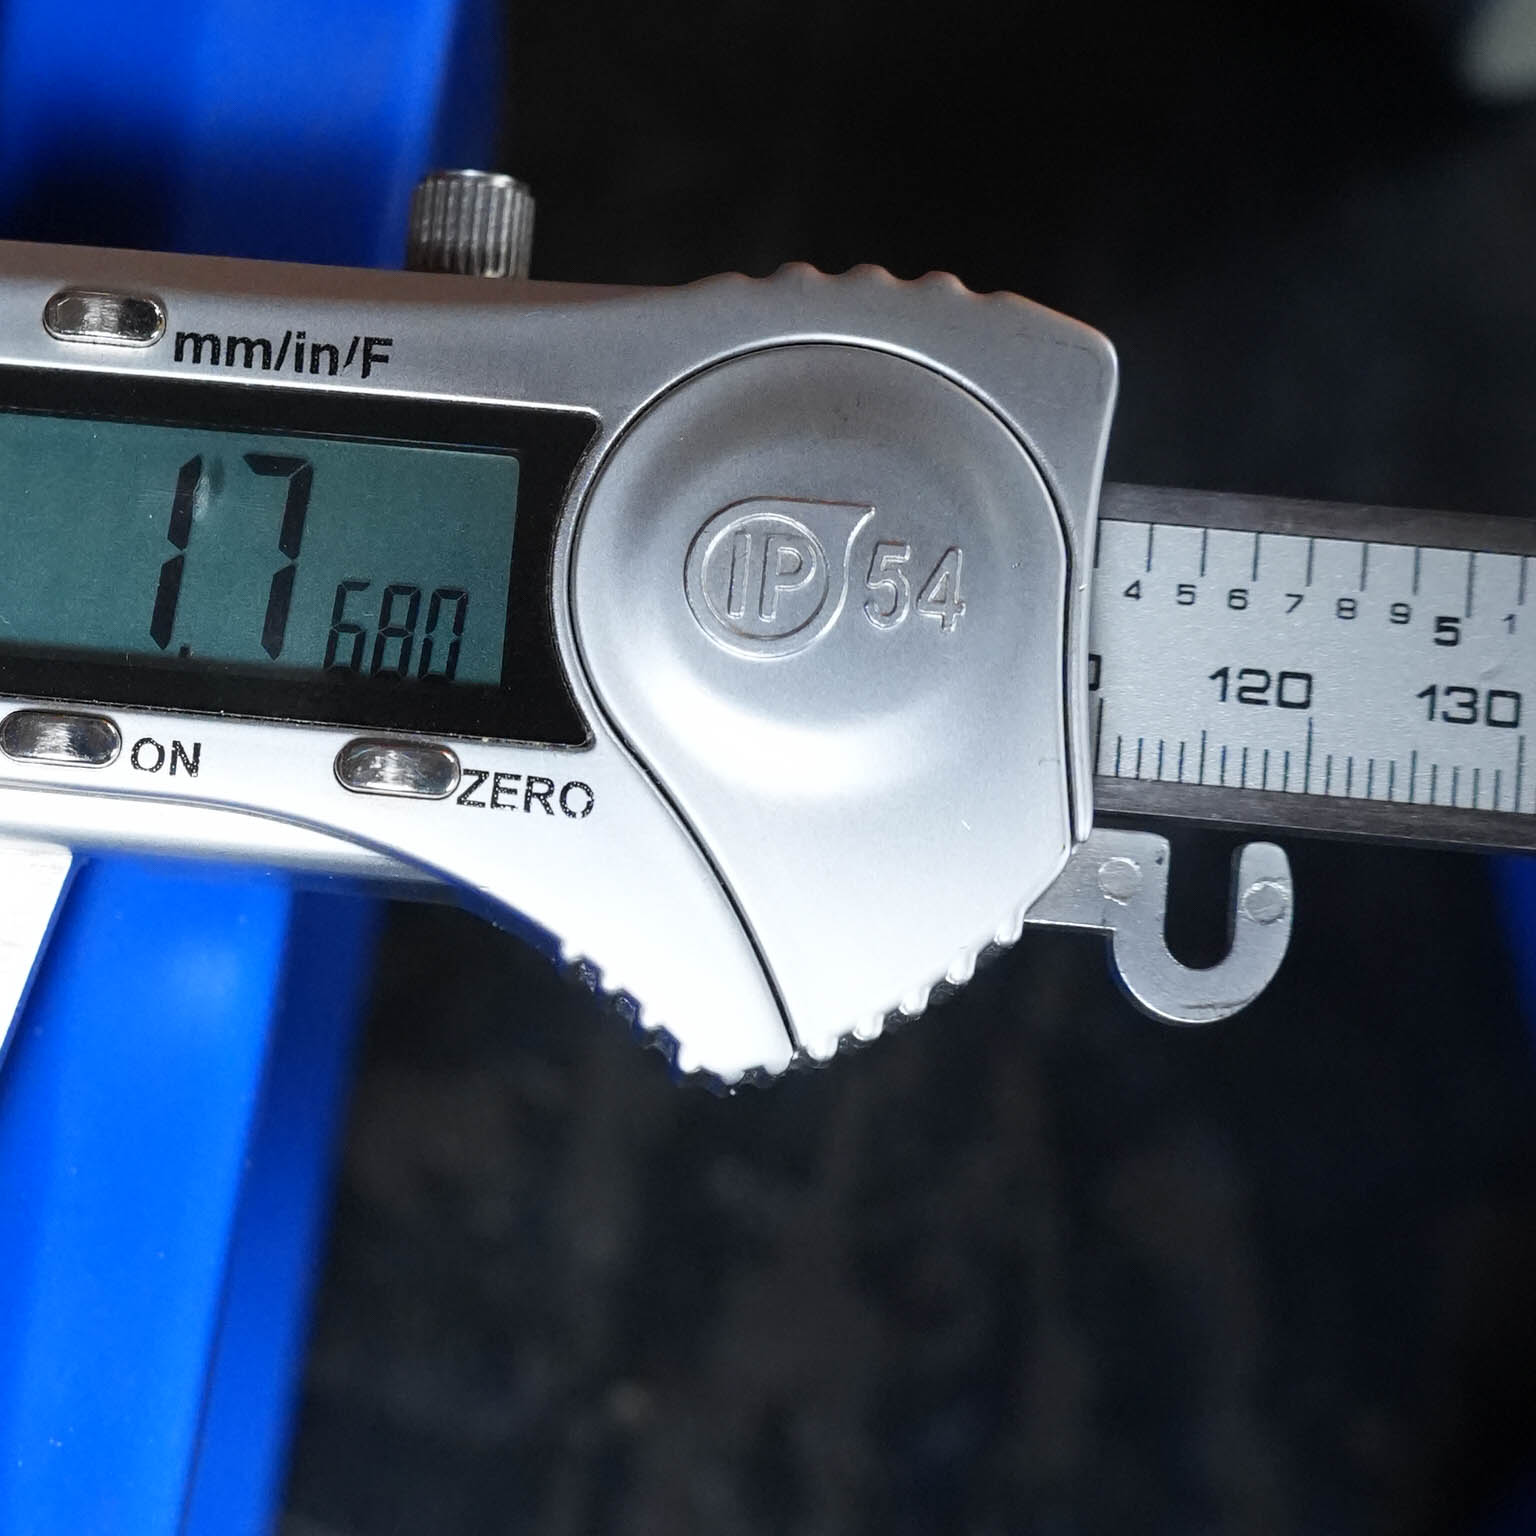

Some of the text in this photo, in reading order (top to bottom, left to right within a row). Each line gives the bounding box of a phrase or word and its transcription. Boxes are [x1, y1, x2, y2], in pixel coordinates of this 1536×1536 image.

[174, 330, 394, 379] mm/in/F
[726, 530, 966, 633] IP 54
[1124, 579, 1516, 647] 4 5 6 7 8 9 5 1
[1208, 666, 1523, 729] 120 130
[131, 738, 201, 777] ON
[456, 768, 595, 819] ZERO
